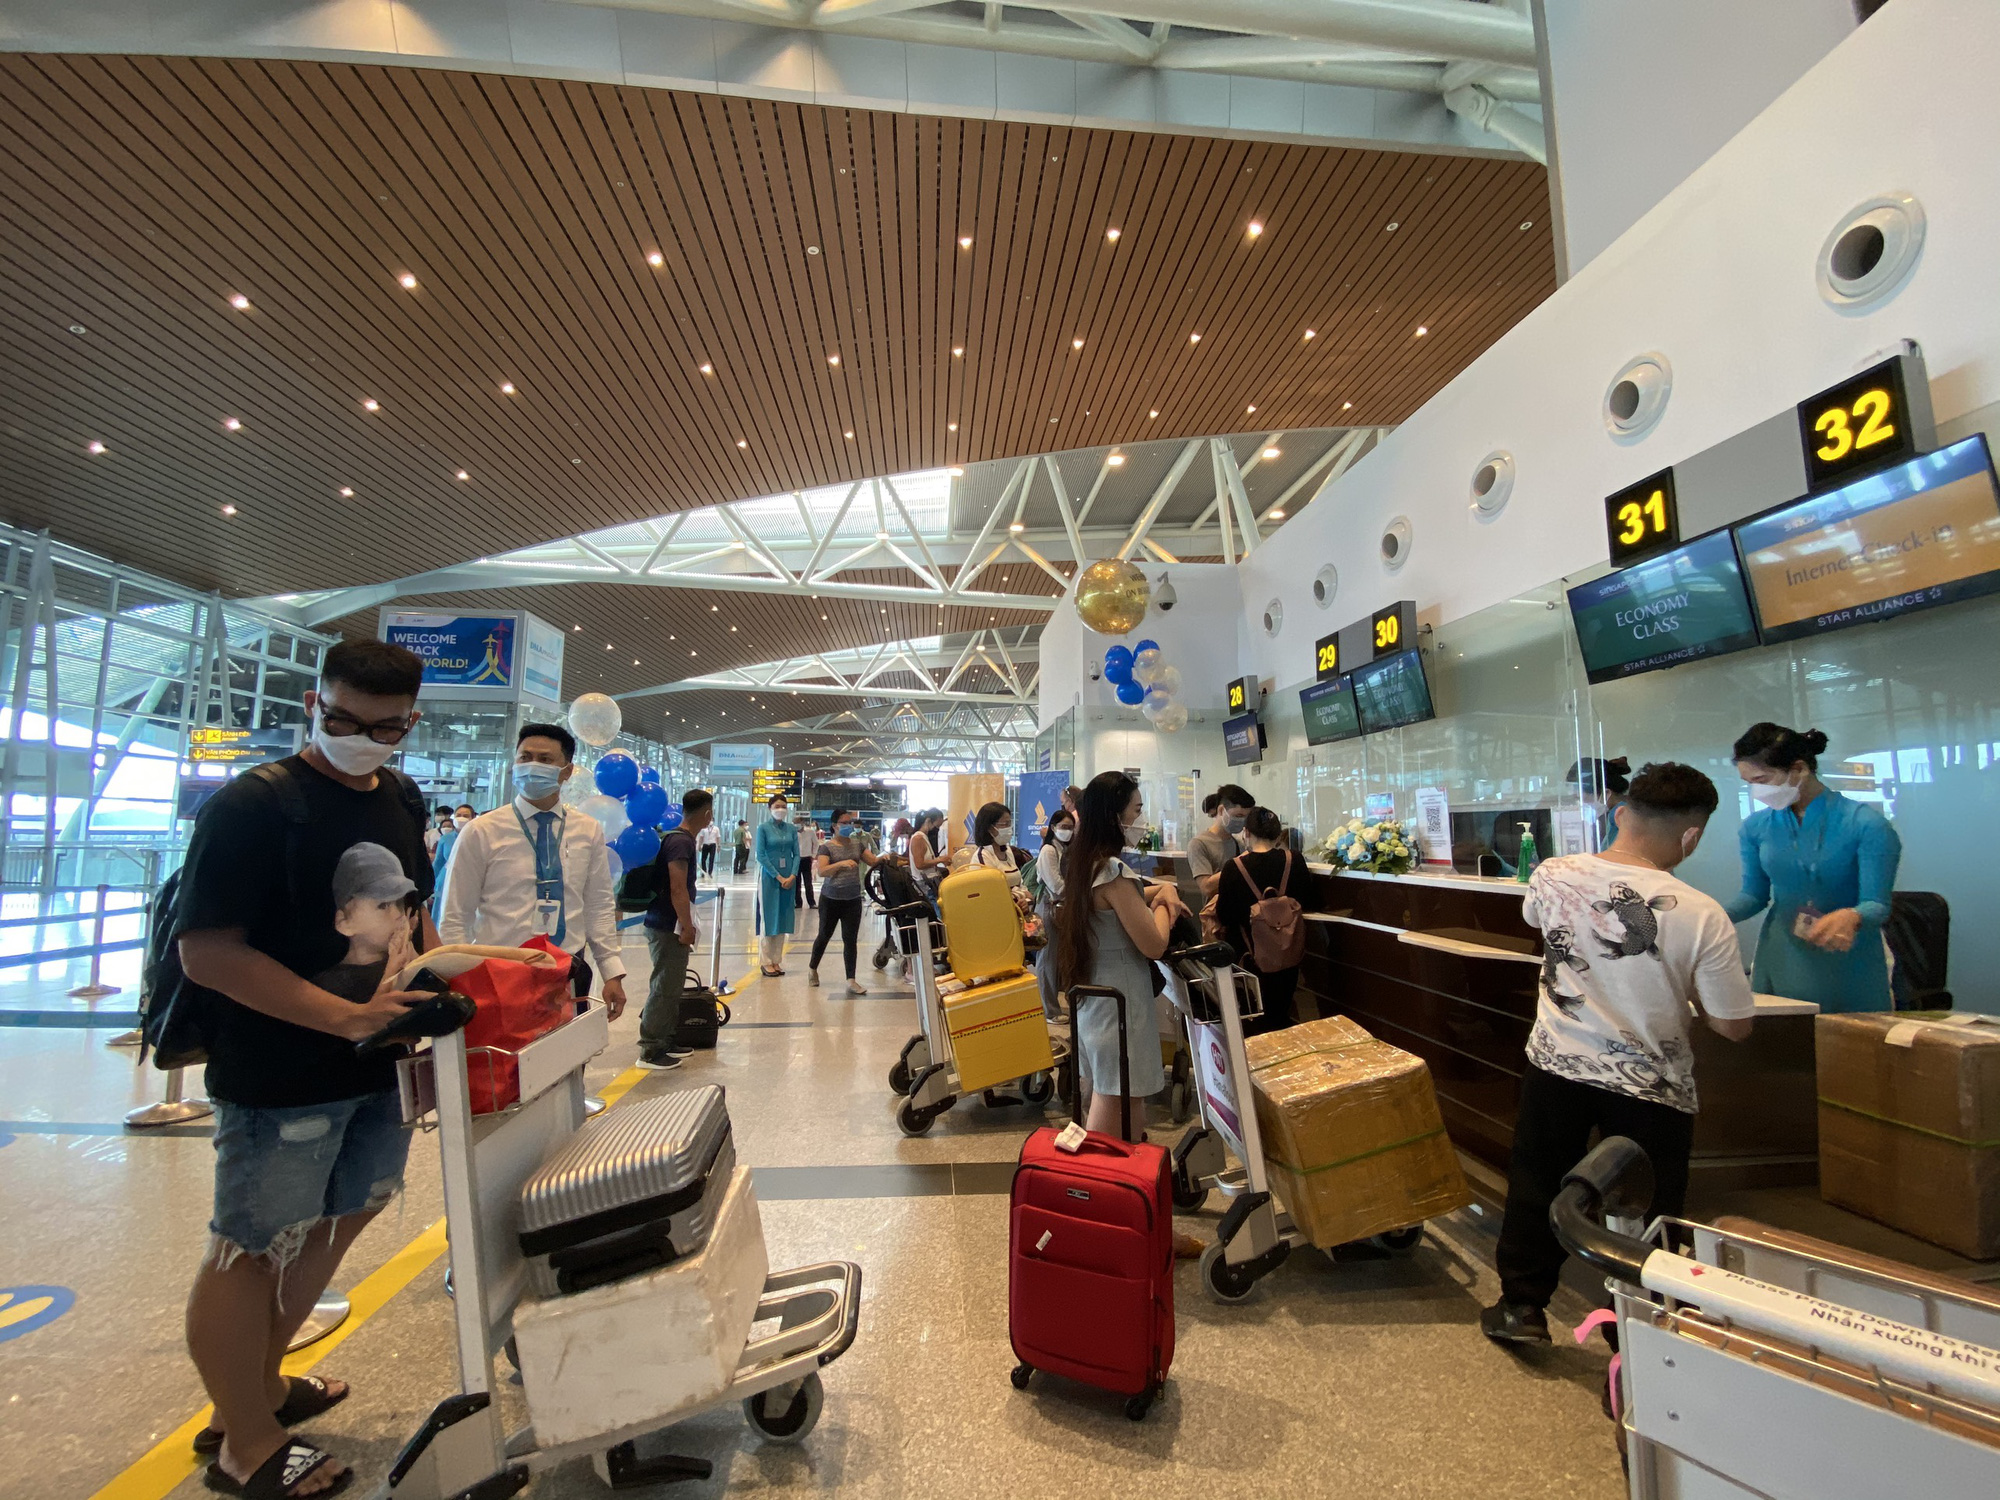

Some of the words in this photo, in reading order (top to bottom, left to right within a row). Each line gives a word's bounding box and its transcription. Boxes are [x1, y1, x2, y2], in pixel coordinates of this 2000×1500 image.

[1814, 389, 1895, 462] 32
[1618, 489, 1668, 546] 31
[1615, 592, 1690, 628] ECONOMY
[1817, 611, 1851, 627] STAR
[1855, 592, 1925, 620] ALLIANCE
[394, 632, 457, 645] WELCOME
[1375, 615, 1398, 648] 30
[1633, 615, 1680, 640] CLASS
[407, 645, 440, 656] BACK
[1318, 644, 1336, 671] 29
[1623, 659, 1646, 672] STAR
[1648, 647, 1695, 665] ALLIANCE
[1230, 685, 1243, 707] 28
[1316, 702, 1340, 717] ECONOMY
[1322, 714, 1338, 725] CLASS
[1725, 1273, 1790, 1296] Please
[1795, 1295, 1854, 1316] Press
[1860, 1313, 1922, 1337] Down
[1951, 1350, 1987, 1368] khi
